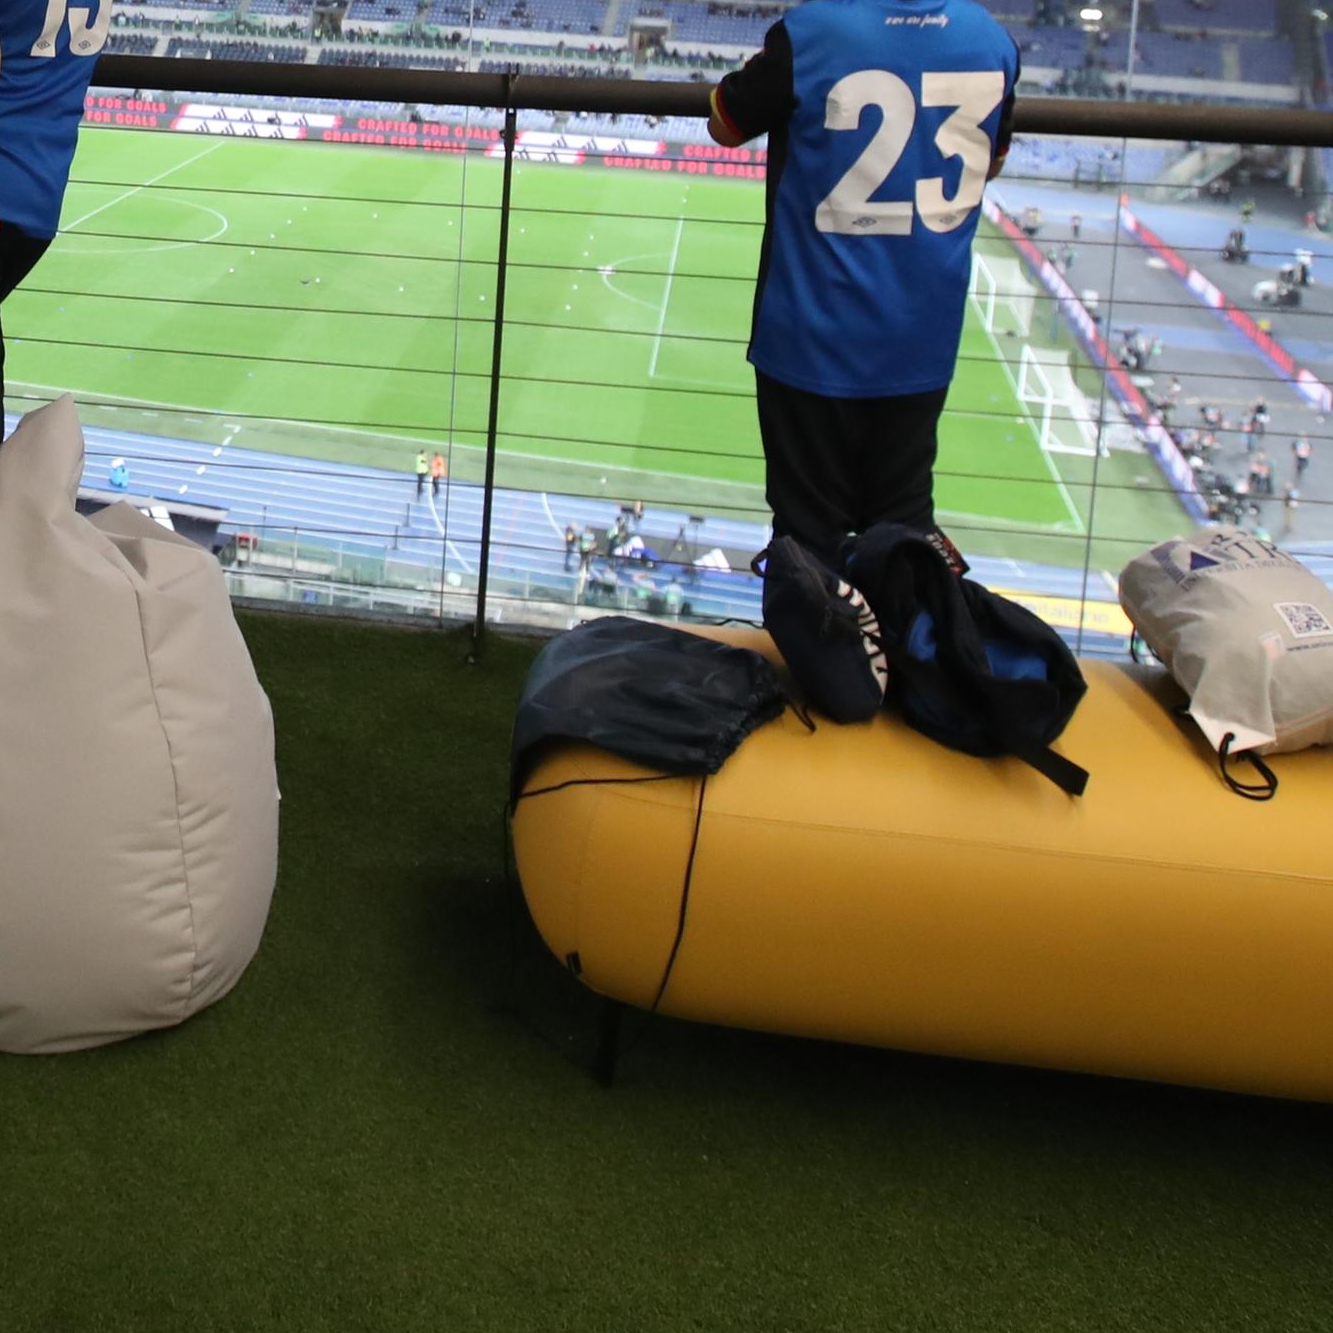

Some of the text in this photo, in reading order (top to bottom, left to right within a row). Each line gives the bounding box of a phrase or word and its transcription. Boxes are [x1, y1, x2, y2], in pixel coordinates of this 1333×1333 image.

[98, 97, 123, 110] FOR
[127, 99, 167, 114] GOALS
[86, 110, 158, 127] FOR GOALS
[358, 118, 417, 134] CRAFTED
[423, 122, 450, 137] FOR
[683, 144, 751, 162] CRAFTED
[815, 69, 1005, 235] 23
